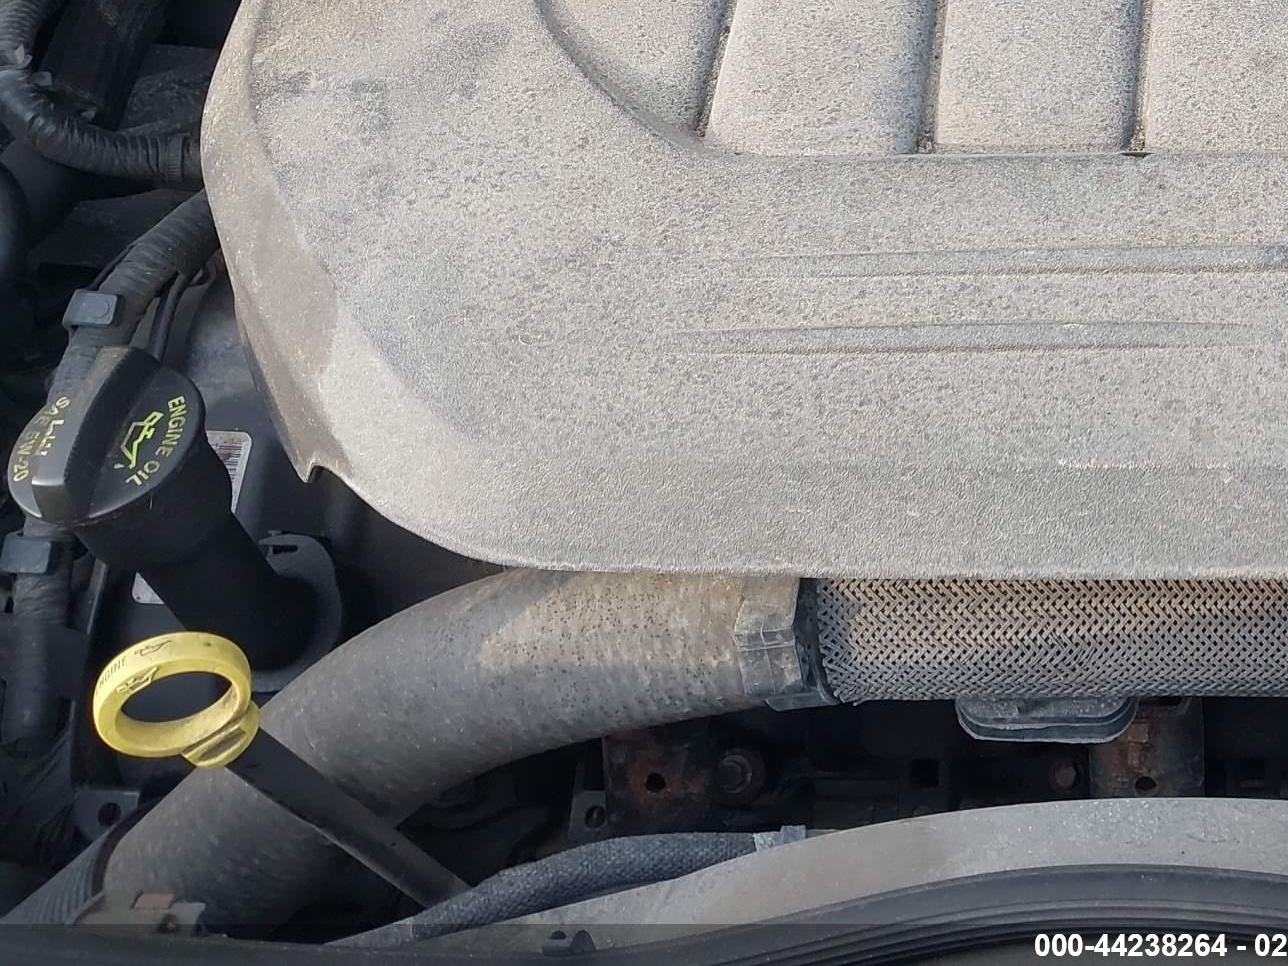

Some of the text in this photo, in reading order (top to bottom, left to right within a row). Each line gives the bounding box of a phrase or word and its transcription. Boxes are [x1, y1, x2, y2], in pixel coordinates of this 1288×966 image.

[125, 395, 187, 485] ENGINE OIL
[95, 656, 128, 694] NGINE
